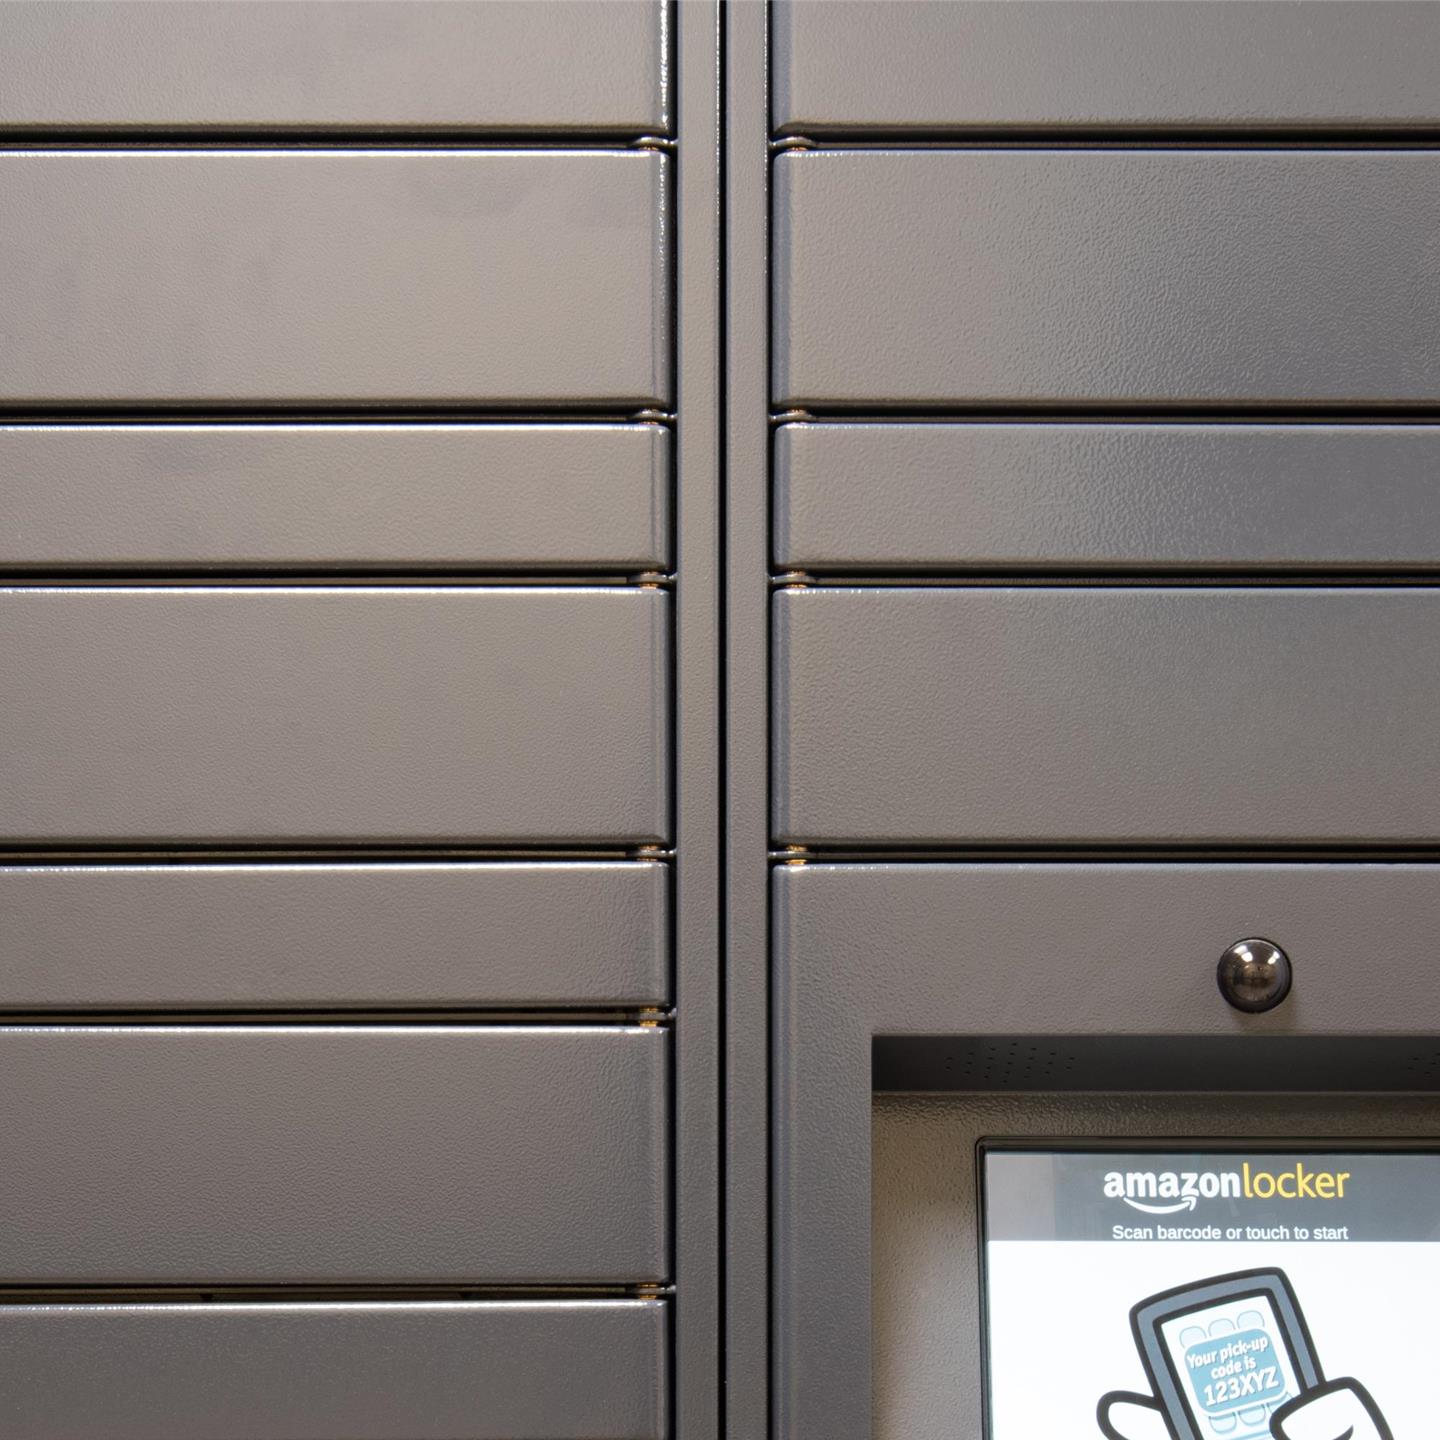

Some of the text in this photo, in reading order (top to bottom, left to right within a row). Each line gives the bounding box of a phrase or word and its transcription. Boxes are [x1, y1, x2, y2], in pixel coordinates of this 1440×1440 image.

[1113, 1225, 1348, 1240] Scan barcode or touch to start
[1187, 1337, 1268, 1368] Your pick-up
[1211, 1356, 1256, 1379] code is
[1204, 1366, 1279, 1406] 123XYZ
